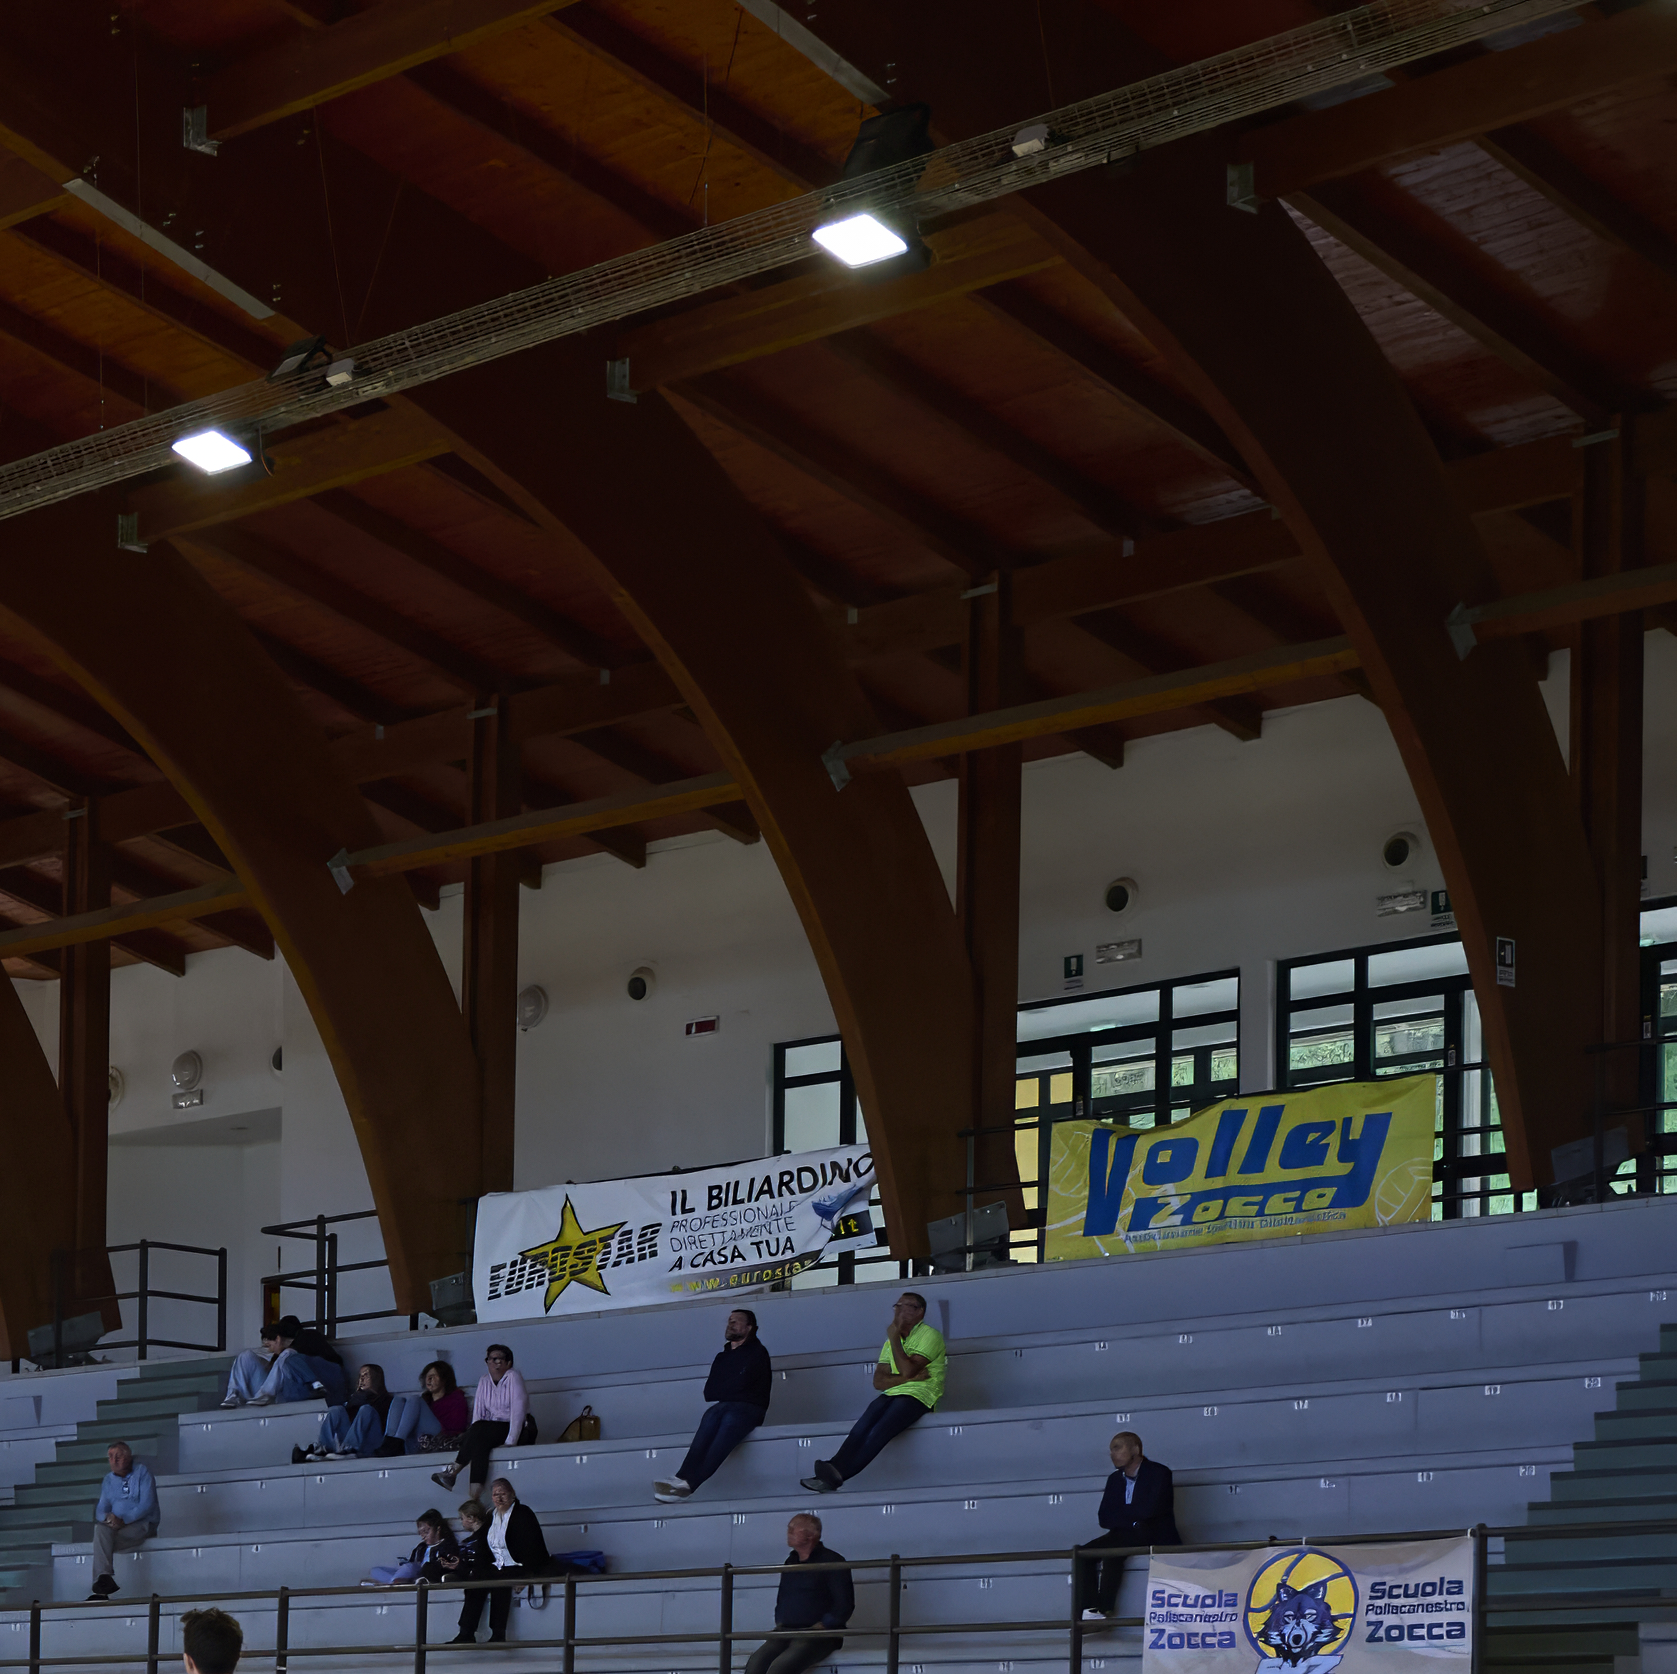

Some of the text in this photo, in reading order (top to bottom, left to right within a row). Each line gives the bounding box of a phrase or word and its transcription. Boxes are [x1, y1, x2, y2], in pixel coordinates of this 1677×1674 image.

[670, 1152, 876, 1217] IL BILIARDINO
[1083, 1104, 1393, 1237] Volley
[670, 1200, 798, 1233] PROFESSIONALE
[1148, 1187, 1338, 1230] Zocca
[669, 1215, 797, 1253] DIRETTAMENTE
[668, 1235, 796, 1273] A CASA TUA
[1150, 1589, 1239, 1609] Scuola
[1368, 1576, 1464, 1602] Scuola
[1148, 1627, 1237, 1650] Zocca
[1365, 1620, 1466, 1643] Zocca
